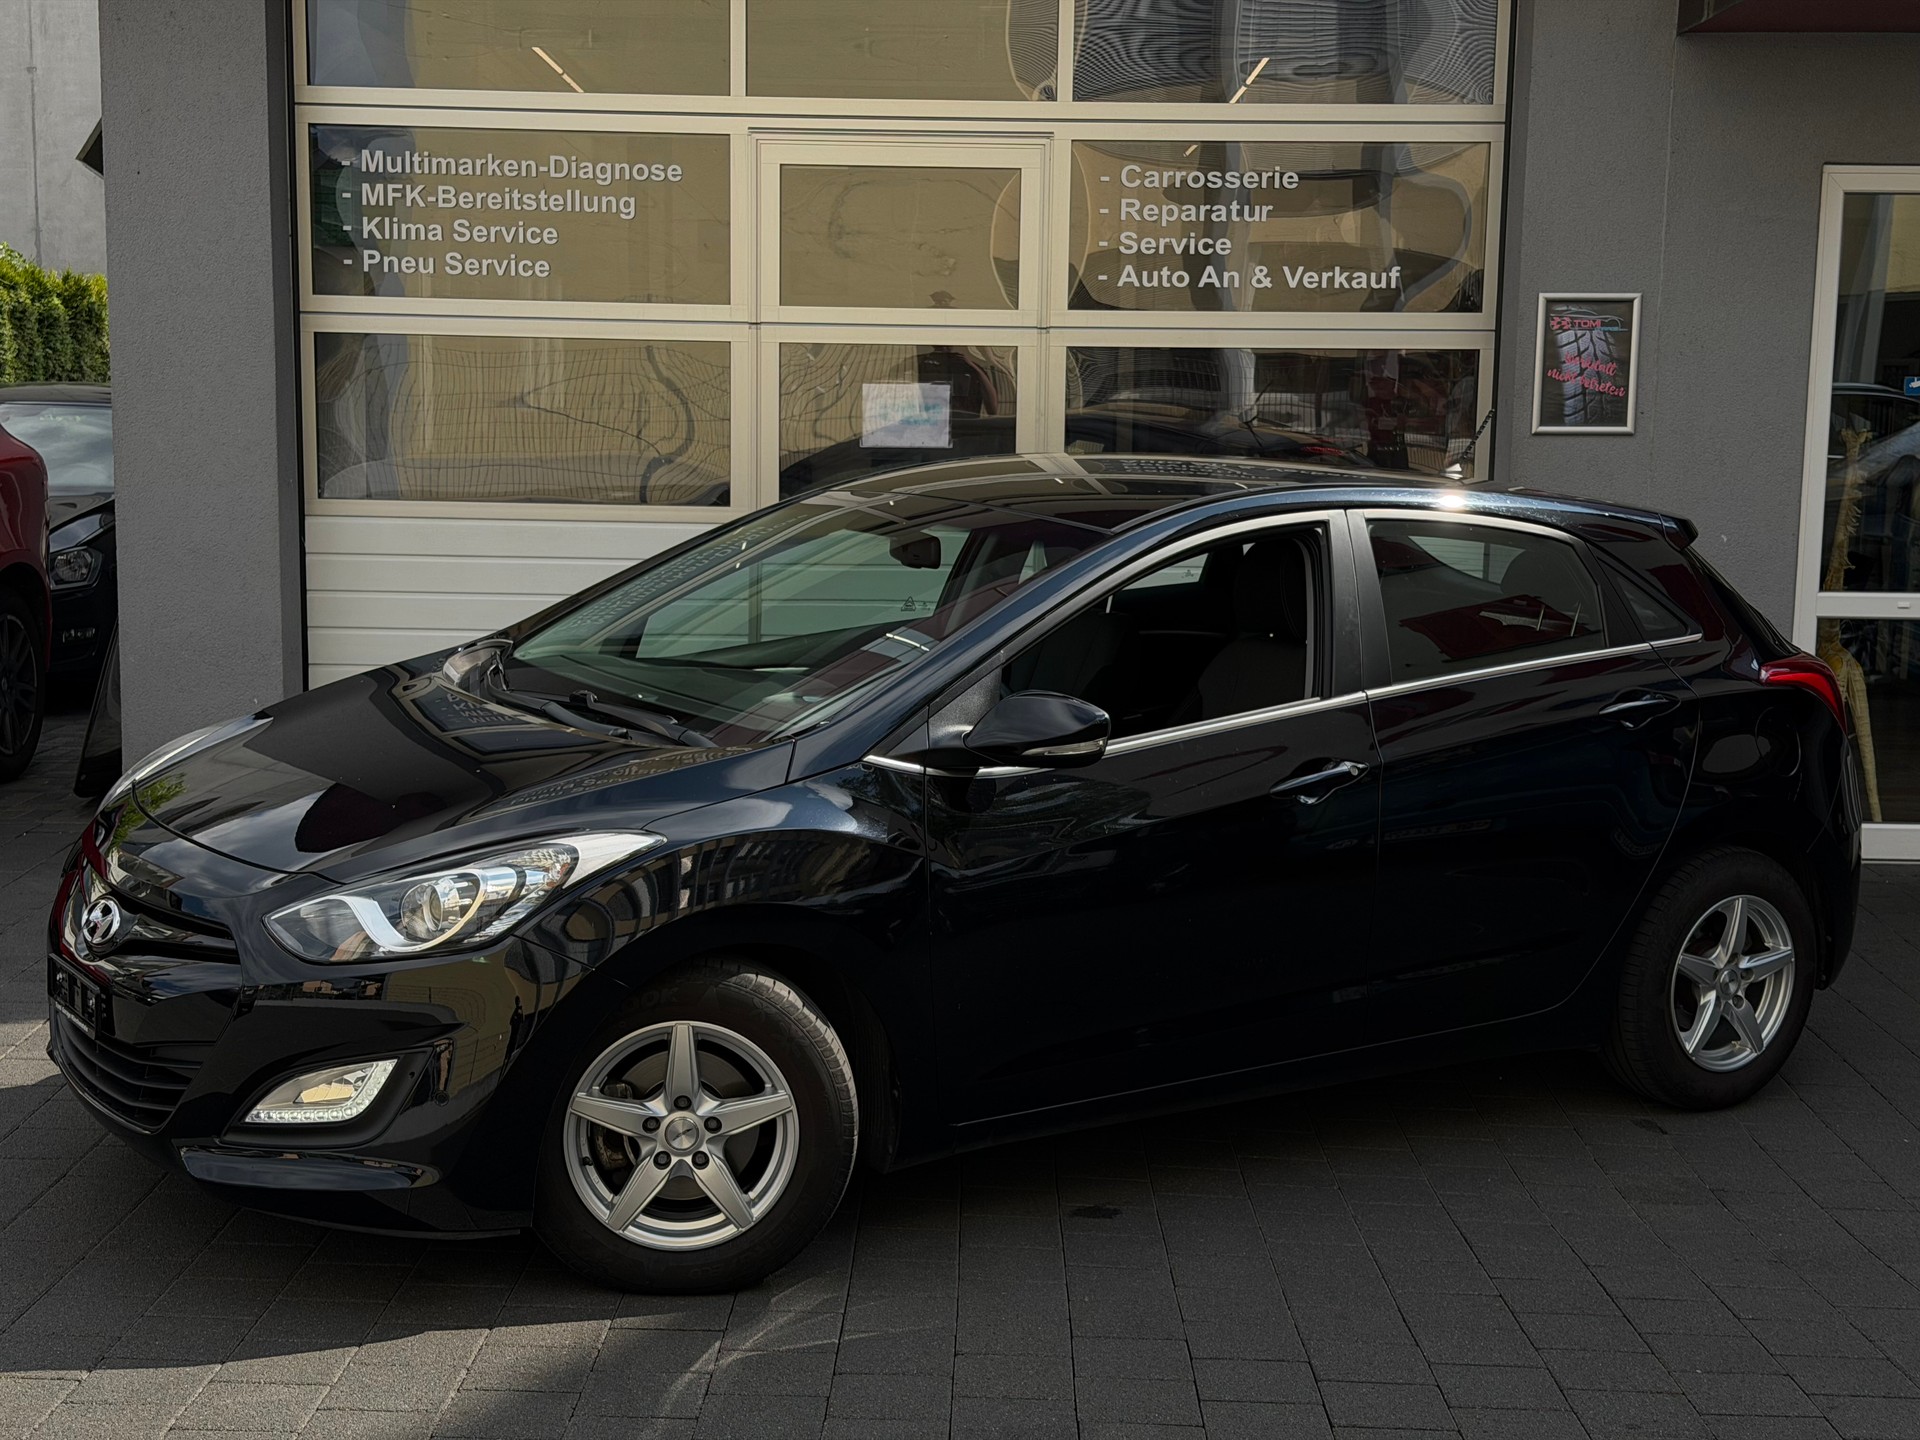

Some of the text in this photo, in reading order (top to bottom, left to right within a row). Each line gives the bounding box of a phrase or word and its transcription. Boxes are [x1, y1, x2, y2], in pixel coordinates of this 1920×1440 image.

[360, 149, 684, 186] Multimarken-Diagnose
[1120, 164, 1300, 190] Carrosserie
[361, 183, 637, 220] MFK-Bereitstellung
[1119, 198, 1273, 227] Reparatur
[361, 217, 444, 242] Klima
[452, 219, 559, 245] Service
[1118, 231, 1232, 256] Service
[362, 250, 435, 275] Pneu
[444, 252, 551, 278] Service
[1117, 265, 1190, 288] Auto
[1198, 265, 1240, 288] An
[1250, 265, 1273, 289] &
[1282, 265, 1402, 289] Verkauf
